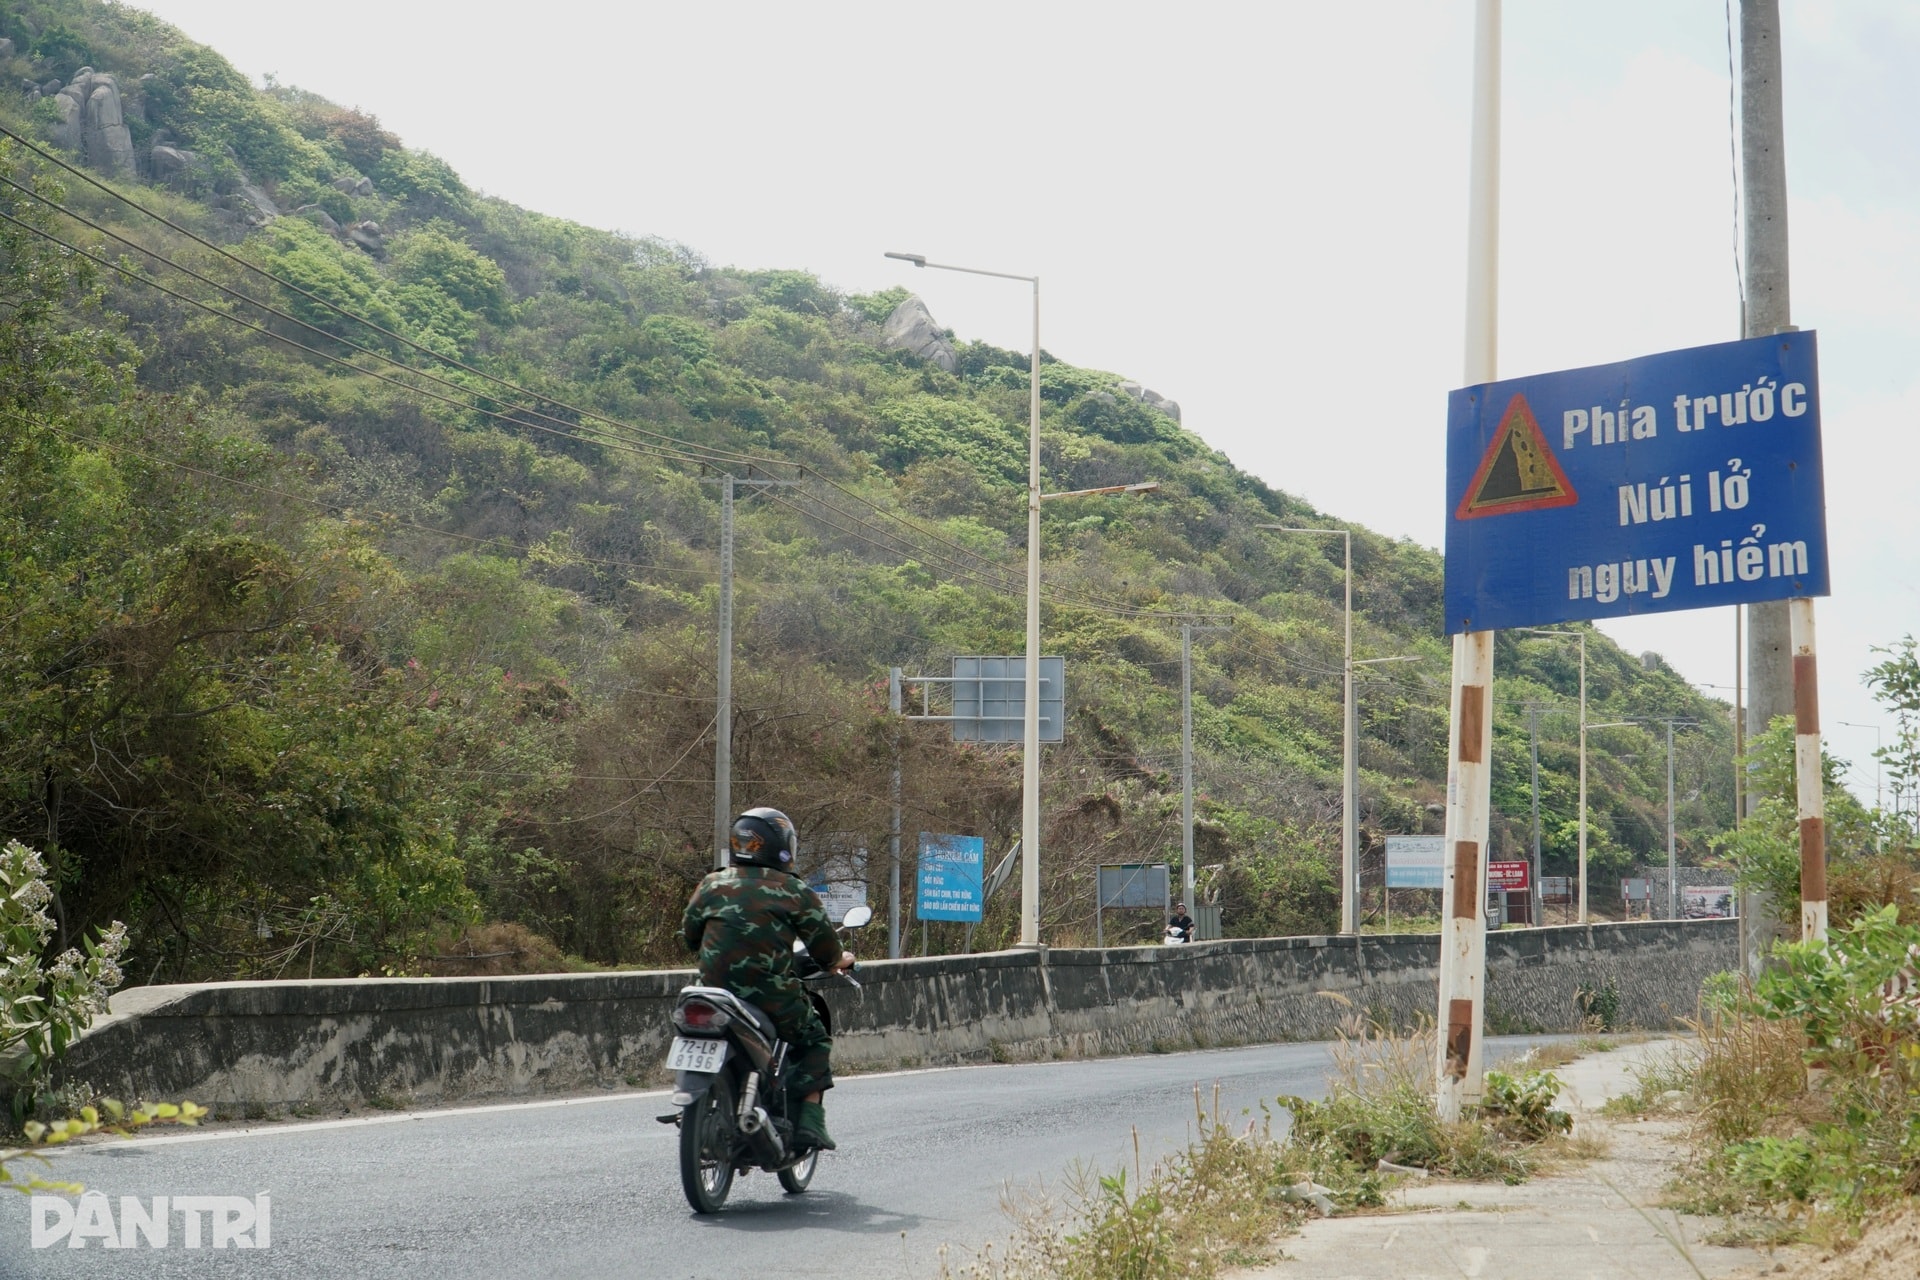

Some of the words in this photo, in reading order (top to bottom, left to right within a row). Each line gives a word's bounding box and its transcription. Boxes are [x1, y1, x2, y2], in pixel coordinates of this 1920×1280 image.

[1563, 398, 1657, 450] Phía
[1674, 375, 1808, 433] trước
[1618, 474, 1693, 526] Núi
[1708, 458, 1752, 513] lở
[1568, 556, 1677, 604] nguy
[1693, 523, 1810, 587] hiểm
[963, 848, 979, 864] CẤM
[675, 1055, 714, 1069] 8196
[679, 1040, 718, 1055] 72-L8
